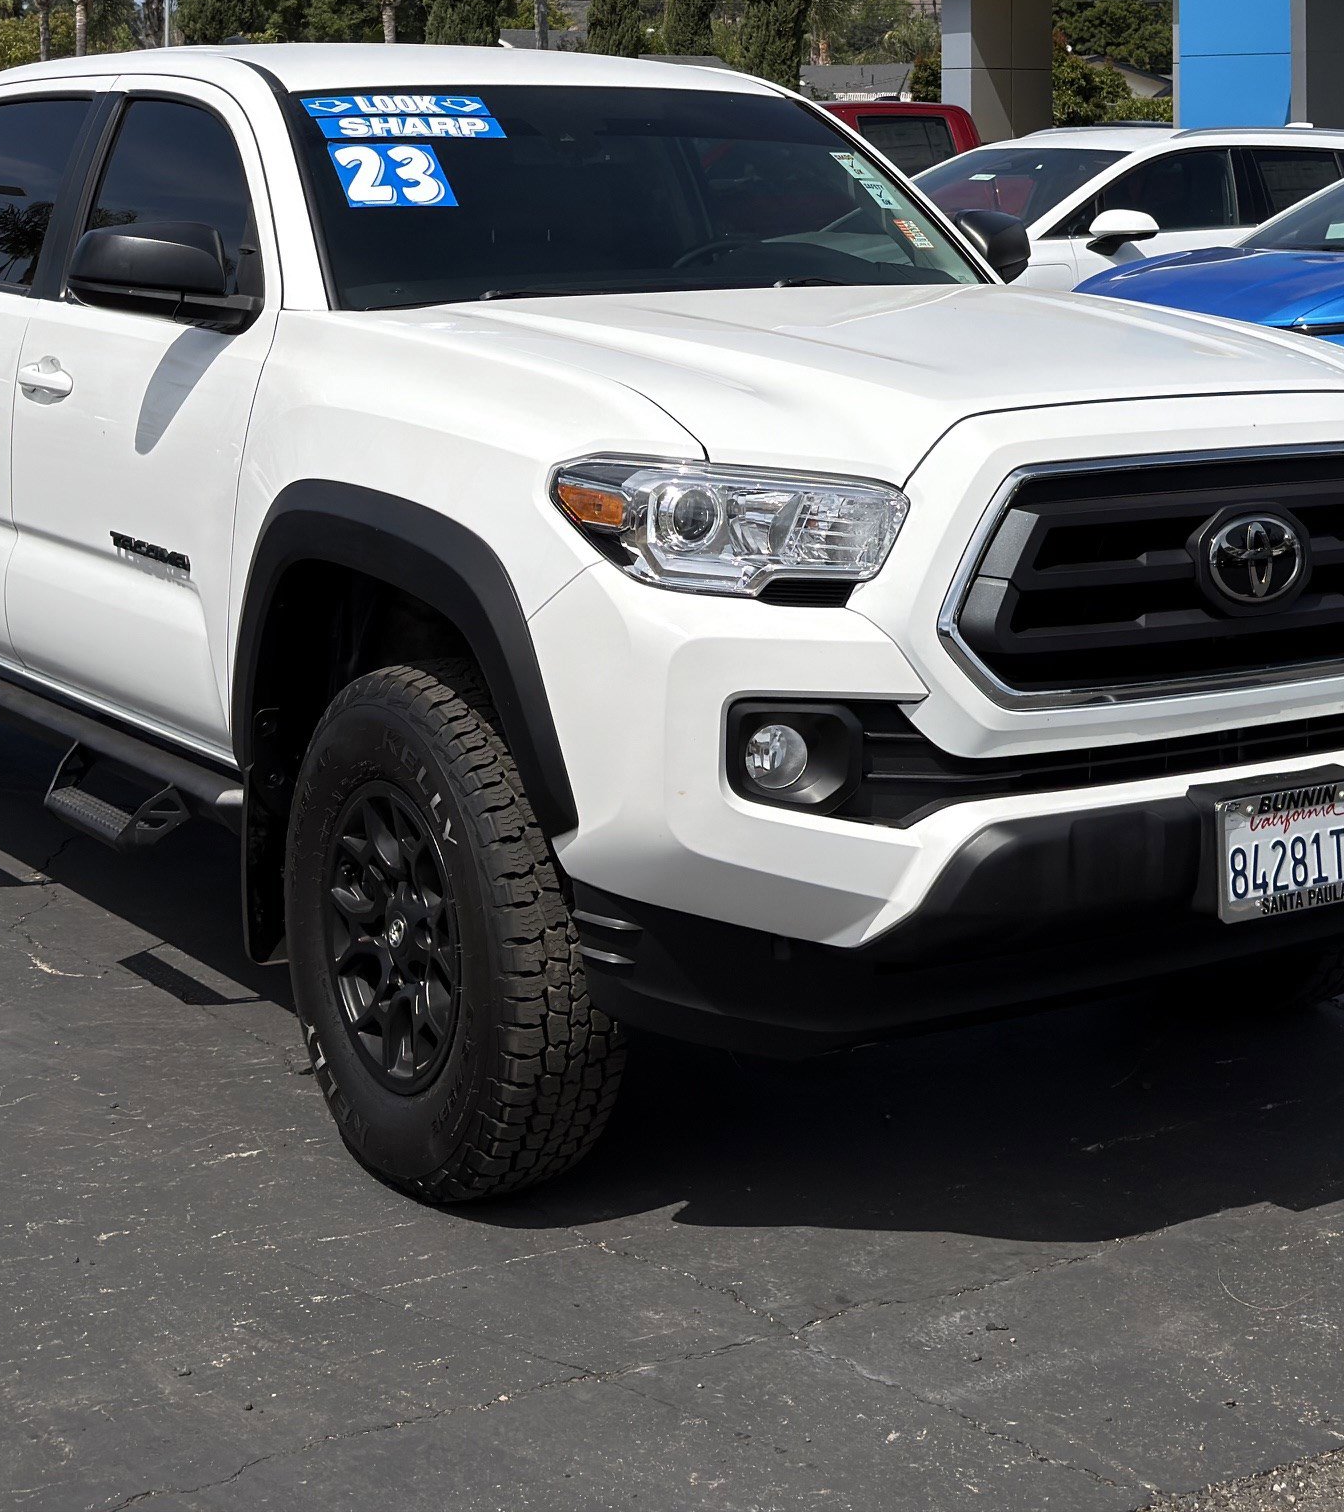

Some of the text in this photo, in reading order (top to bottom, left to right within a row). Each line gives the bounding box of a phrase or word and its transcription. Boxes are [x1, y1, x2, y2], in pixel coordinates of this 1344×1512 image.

[353, 95, 445, 114] LOOK
[338, 117, 489, 137] SHARP
[334, 145, 445, 204] 23
[1258, 784, 1338, 815] BUNNIN
[1260, 892, 1304, 915] SANTA
